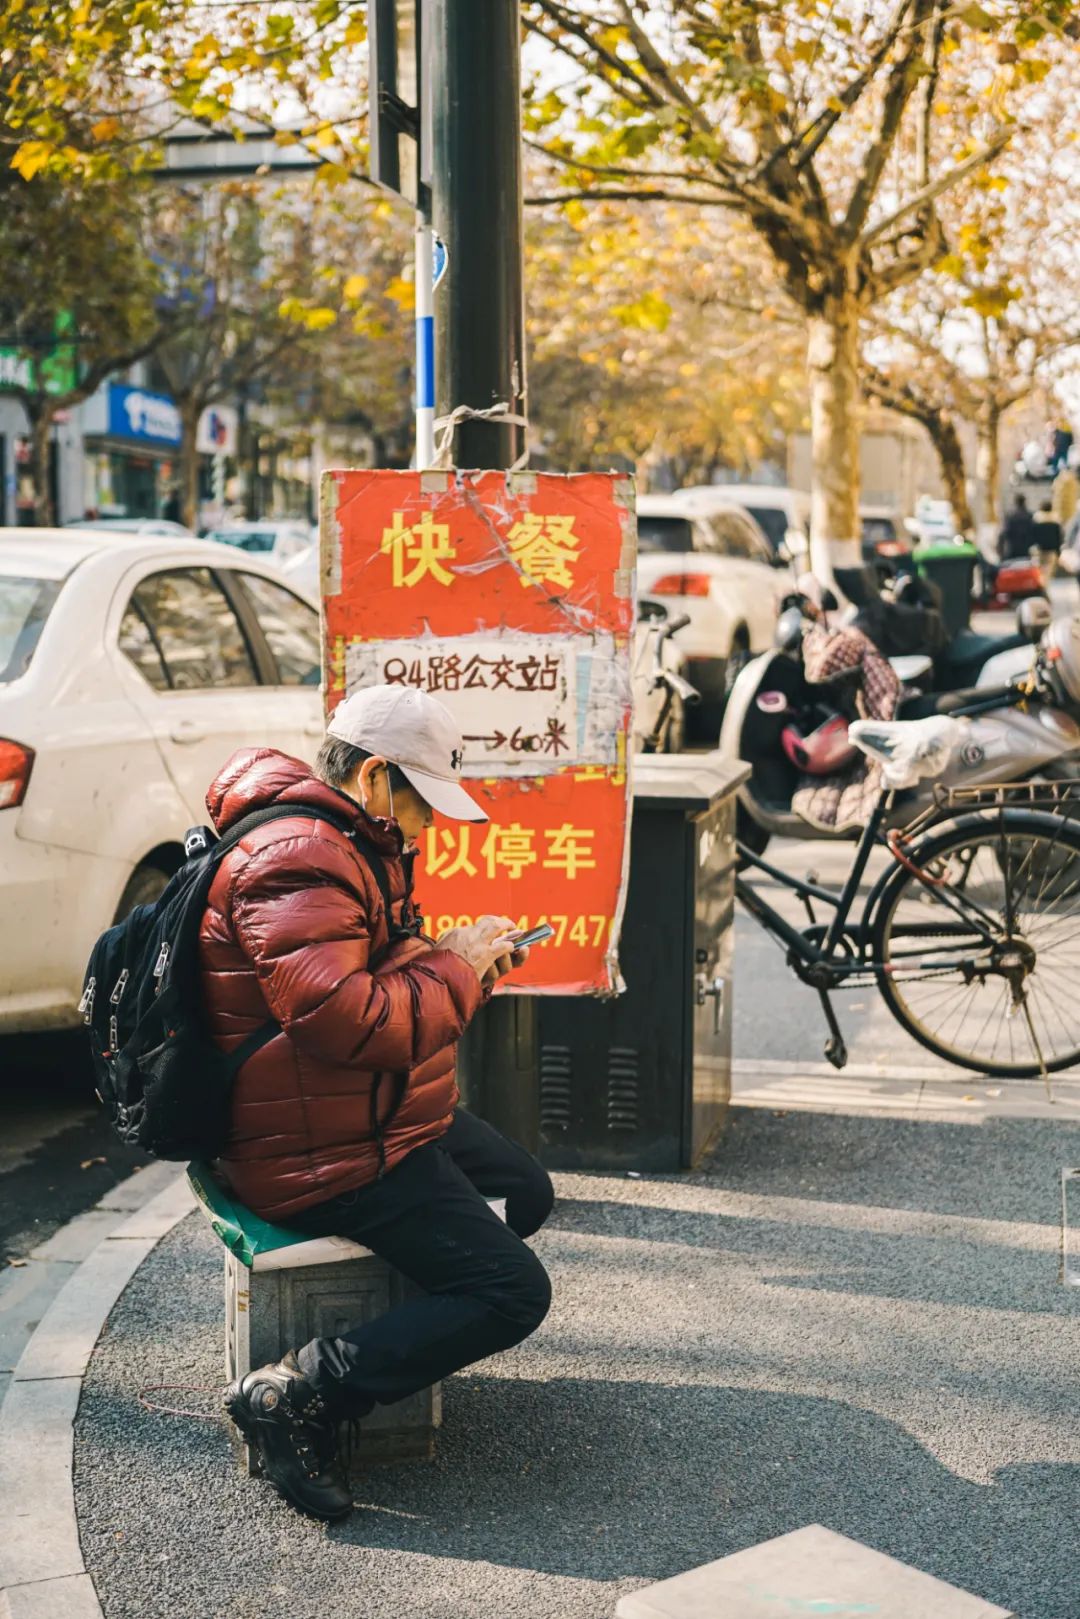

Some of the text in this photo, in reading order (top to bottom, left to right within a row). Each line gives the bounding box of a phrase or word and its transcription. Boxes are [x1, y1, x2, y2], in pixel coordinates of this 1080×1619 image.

[381, 511, 580, 589] 快餐
[425, 823, 596, 880] 以停车
